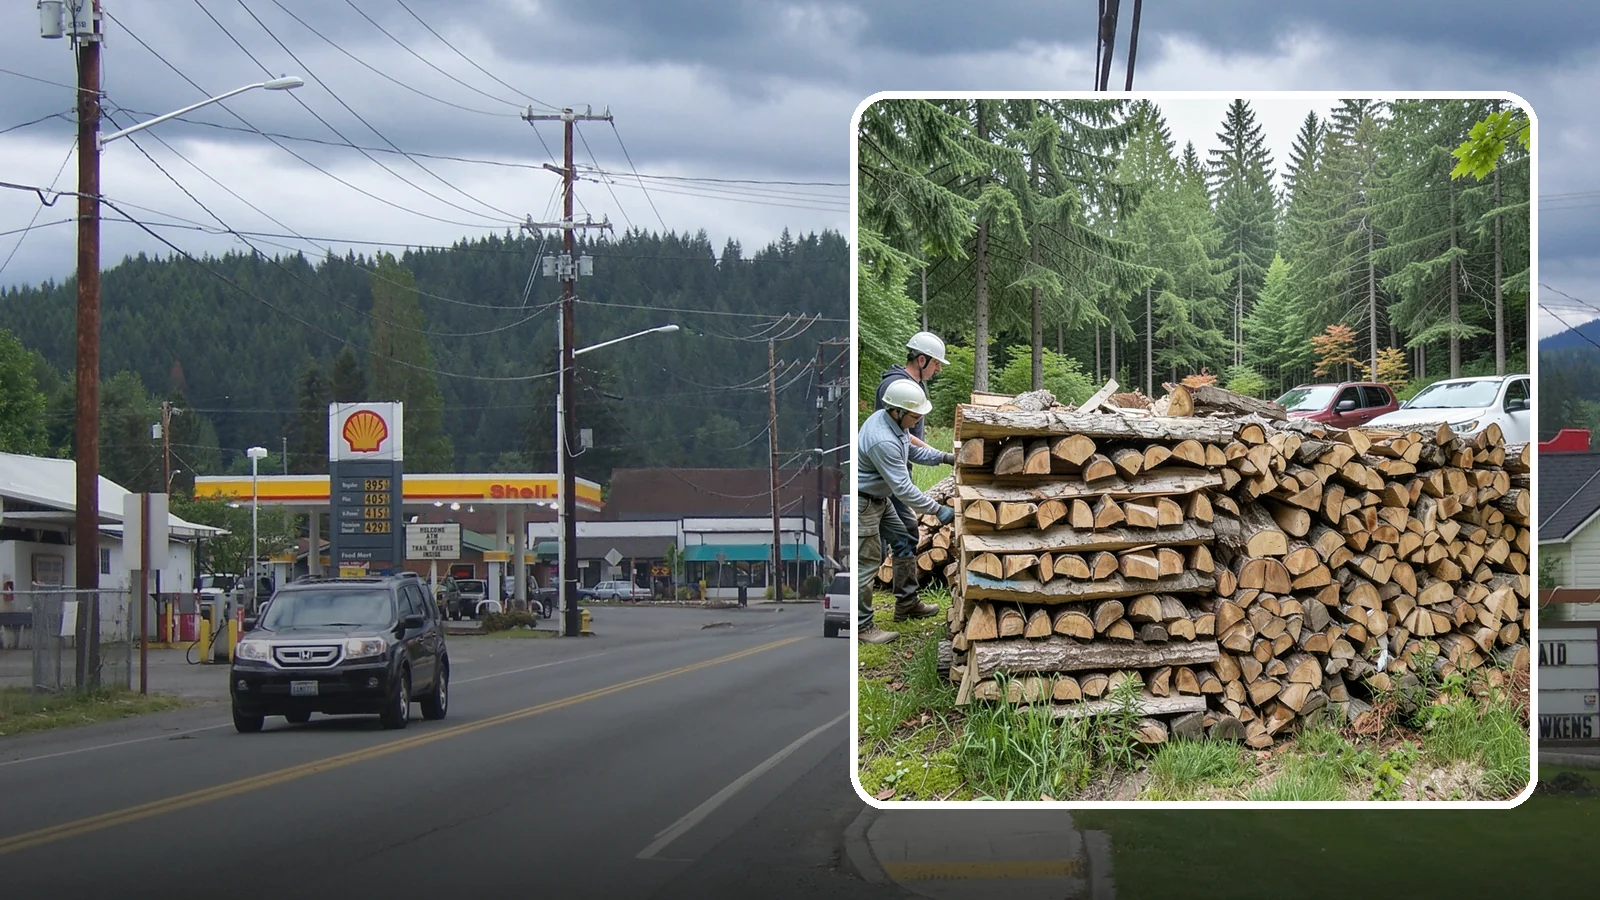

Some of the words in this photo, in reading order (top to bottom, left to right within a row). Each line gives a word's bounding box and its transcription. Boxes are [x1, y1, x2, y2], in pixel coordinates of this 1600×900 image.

[366, 480, 383, 490] 395
[490, 484, 547, 498] Shell
[366, 494, 383, 504] 405
[366, 508, 383, 518] 415
[366, 522, 383, 532] 429
